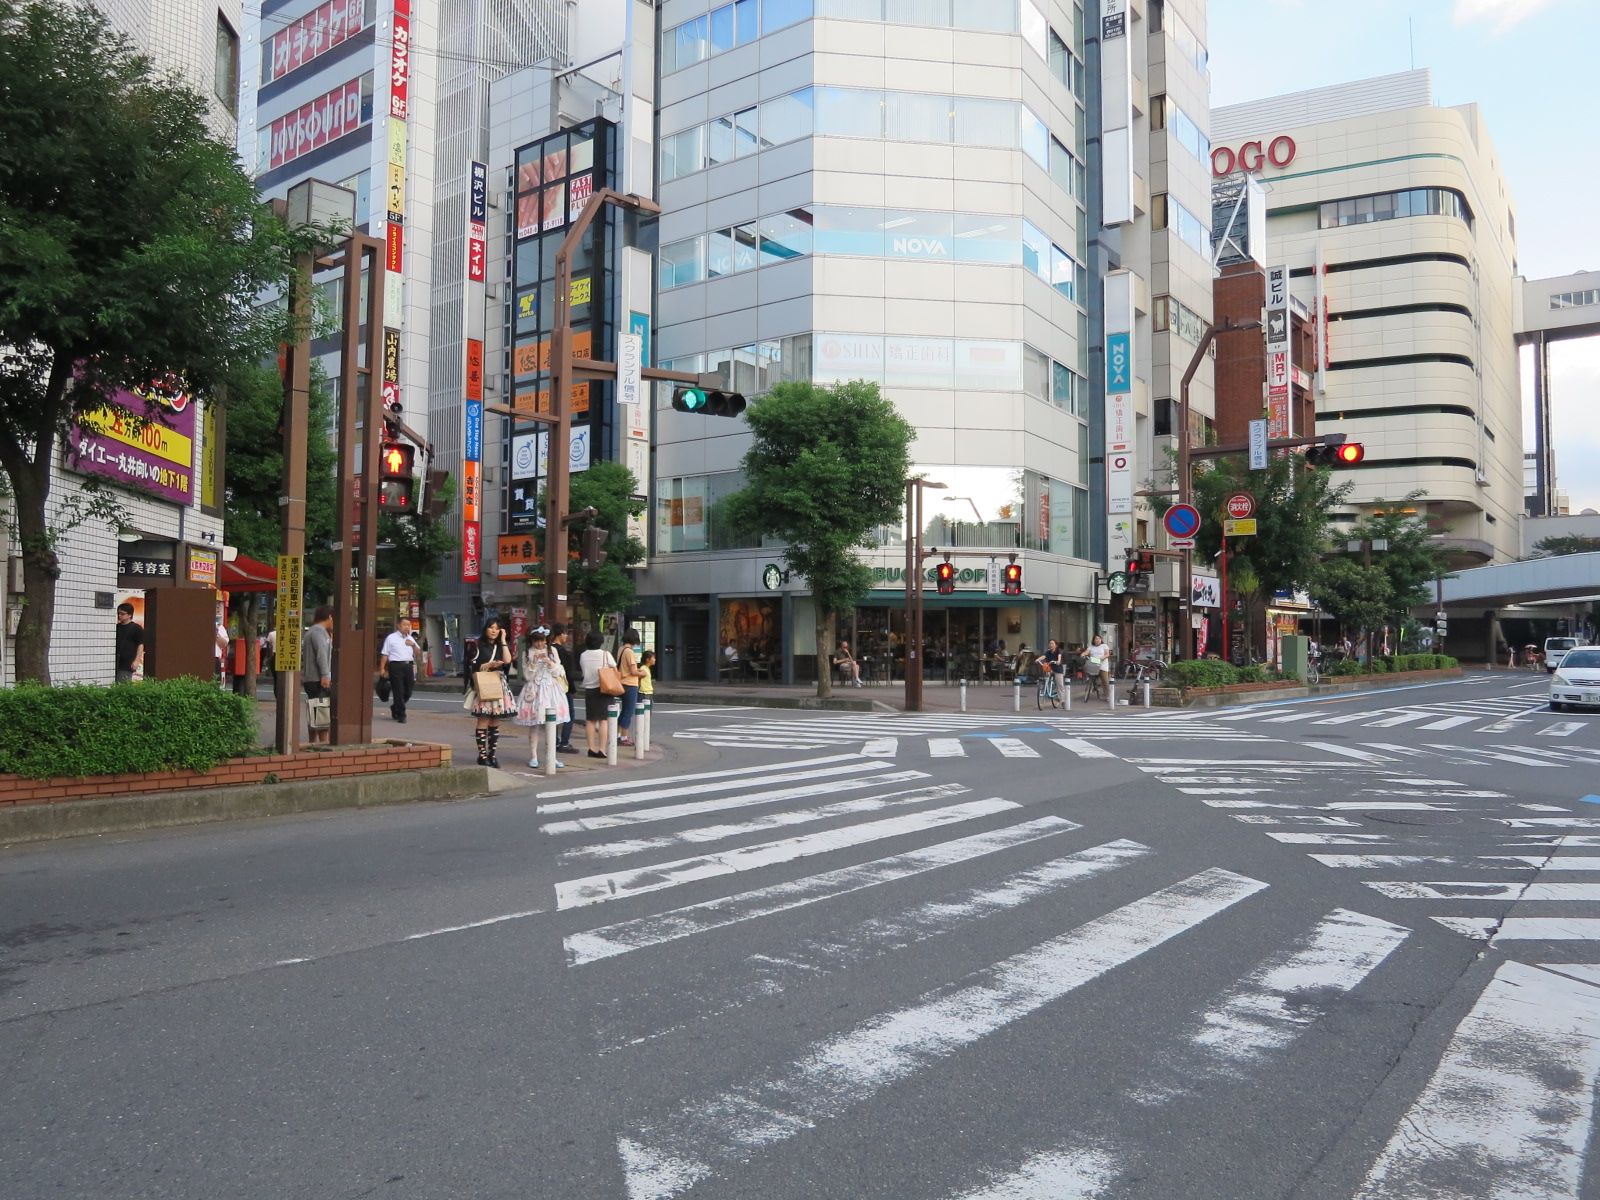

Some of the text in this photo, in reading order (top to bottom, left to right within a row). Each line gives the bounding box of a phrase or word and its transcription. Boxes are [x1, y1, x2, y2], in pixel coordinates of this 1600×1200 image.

[274, 9, 346, 71] カラオケ
[393, 26, 408, 87] カラオケ
[392, 95, 406, 109] 6F
[473, 165, 485, 217] 棚沢ビル
[571, 176, 592, 189] FAST
[571, 187, 591, 201] NAIL
[472, 242, 482, 276] ネイル
[893, 237, 947, 256] NOVA
[1270, 269, 1283, 305] 誠ビル
[386, 333, 398, 382] 山内農場
[624, 336, 635, 401] スクランブル信号
[1112, 344, 1125, 384] NOVA
[1275, 353, 1285, 382] MRT
[501, 544, 518, 557] 牛丼
[132, 561, 170, 575] 美容室
